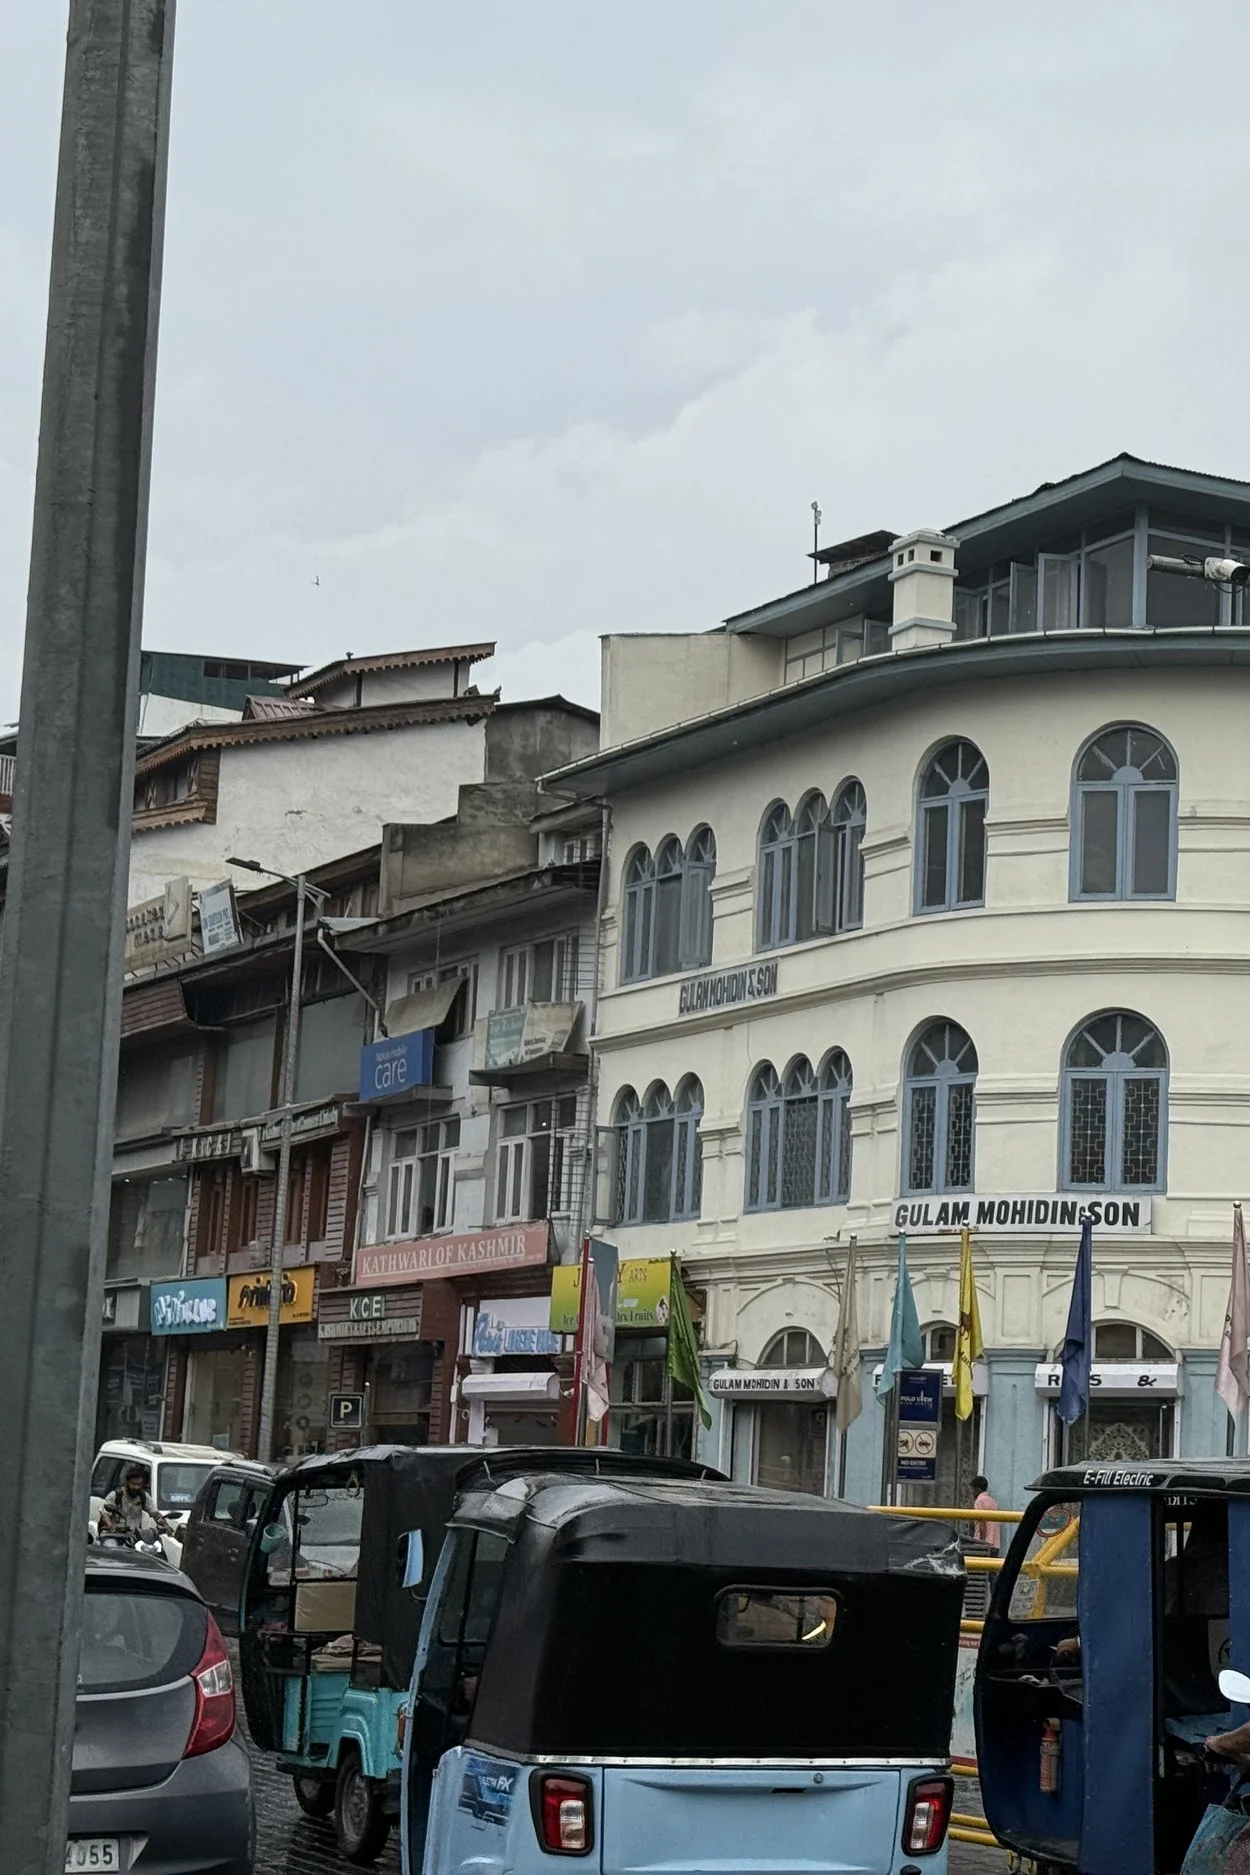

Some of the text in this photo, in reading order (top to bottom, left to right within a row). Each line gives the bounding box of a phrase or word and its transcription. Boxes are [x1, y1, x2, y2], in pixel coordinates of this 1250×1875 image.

[680, 979, 709, 1013] GULAM
[709, 971, 747, 1008] MOHIDIN
[757, 963, 778, 996] SON
[374, 1057, 408, 1089] care
[895, 1201, 970, 1227] GULAM
[976, 1200, 1077, 1226] MOHIDIN
[1088, 1201, 1140, 1226] SON
[363, 1250, 432, 1274] KATHWARI
[436, 1247, 452, 1265] OF
[457, 1234, 526, 1260] KASHMIR
[628, 1267, 648, 1283] ARTS
[350, 1295, 382, 1318] KCE
[713, 1377, 815, 1390] GULAM MOHIDIN & SON
[1137, 1374, 1157, 1387] &
[340, 1401, 353, 1419] P
[1083, 1470, 1154, 1486] E-Fill Electric
